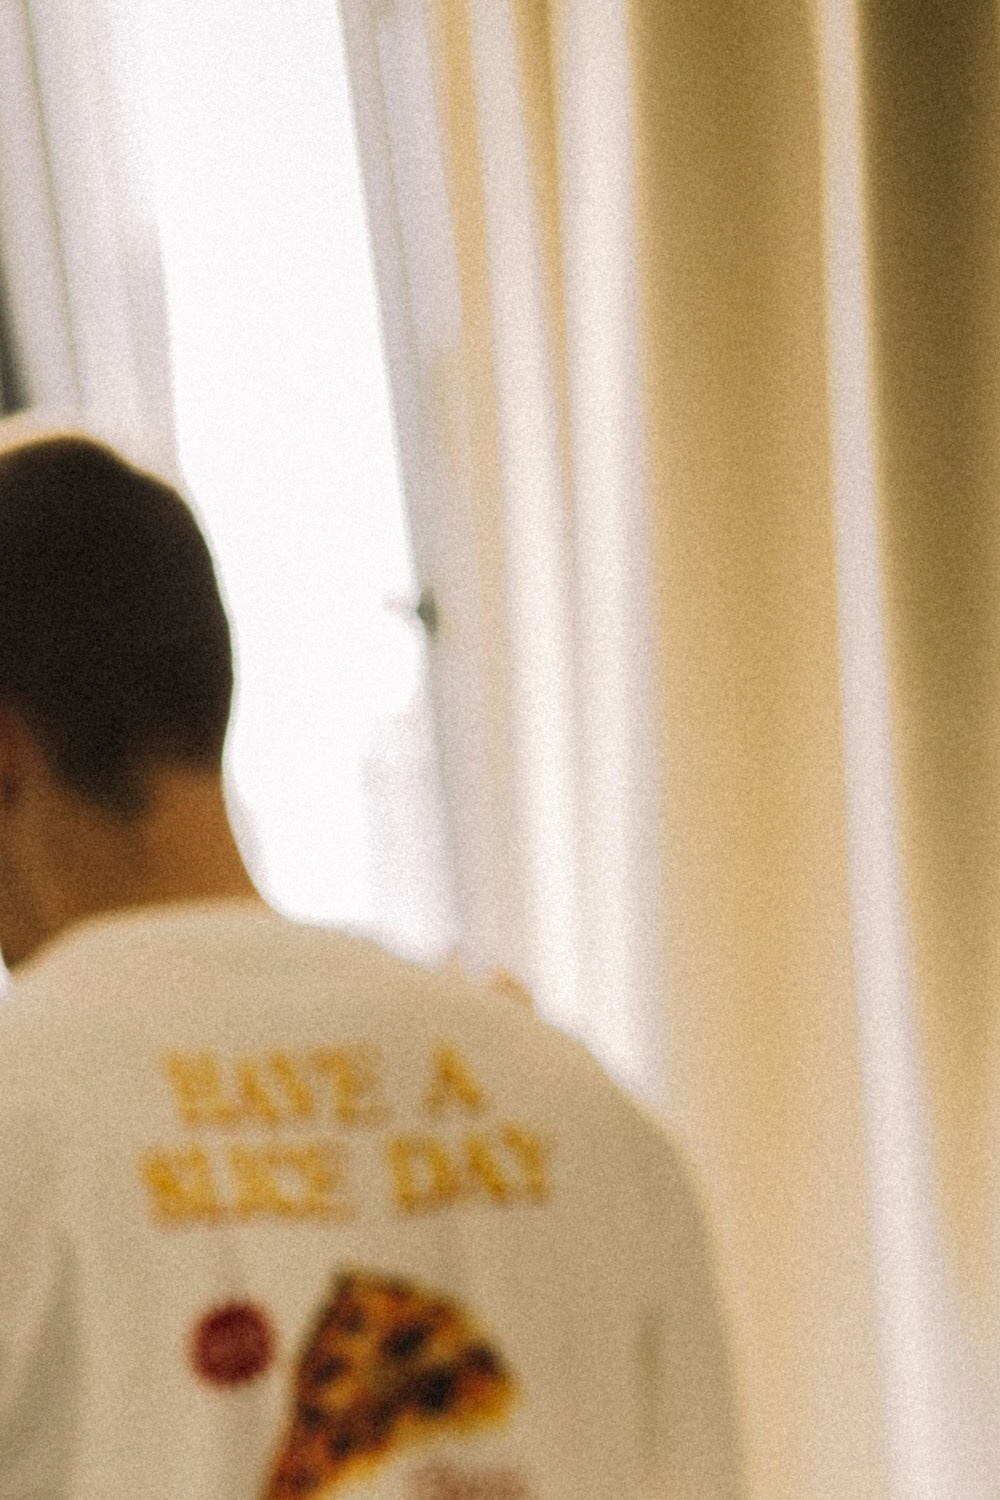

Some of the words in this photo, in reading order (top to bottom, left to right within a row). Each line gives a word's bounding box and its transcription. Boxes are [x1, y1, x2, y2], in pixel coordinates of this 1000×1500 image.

[163, 1048, 391, 1127] HAVE
[424, 1040, 487, 1115] A
[388, 1124, 552, 1216] DAY
